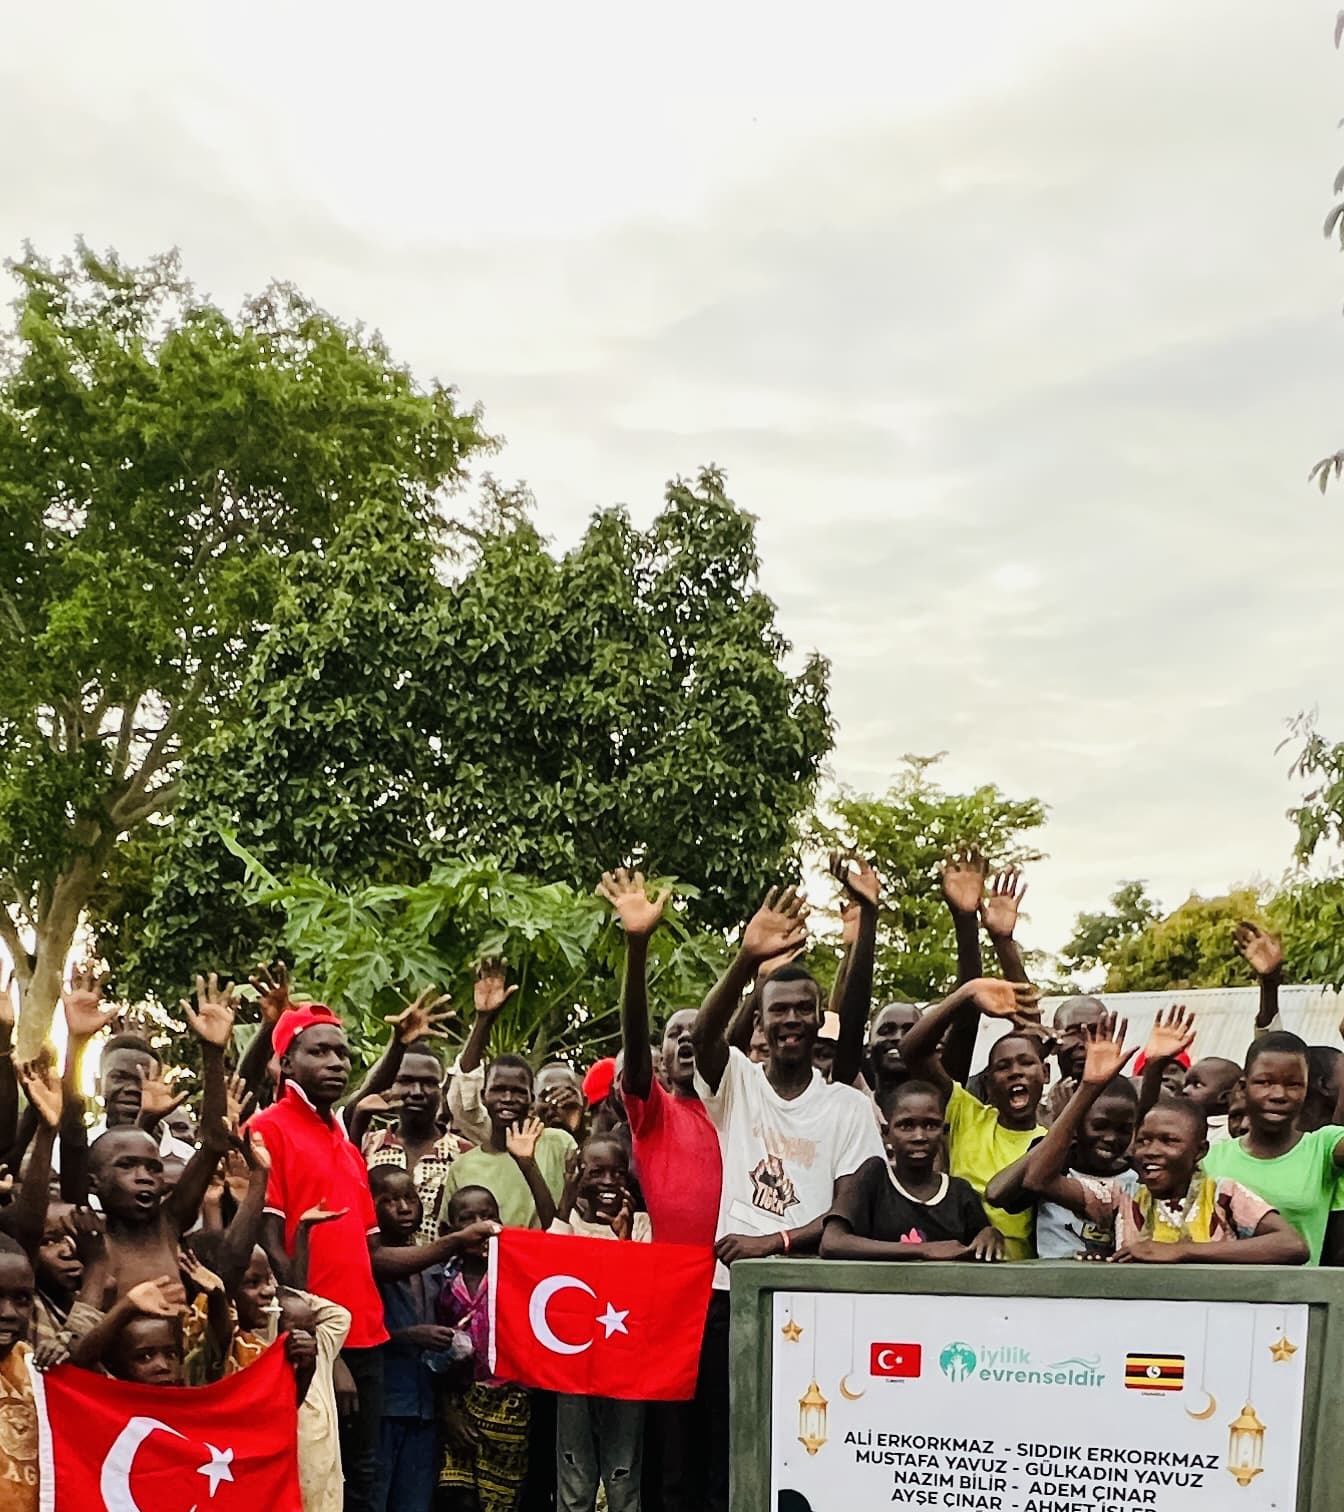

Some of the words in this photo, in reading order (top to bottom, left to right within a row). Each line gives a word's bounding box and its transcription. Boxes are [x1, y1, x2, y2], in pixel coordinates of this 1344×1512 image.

[980, 1344, 1031, 1367] iyilik
[979, 1367, 1106, 1387] evrenseldir
[844, 1428, 873, 1446] ALİ
[877, 1433, 995, 1454] ERKORKMAZ
[1016, 1442, 1082, 1461] SIDDIK
[1087, 1447, 1220, 1470] ERKORKMAZ
[855, 1450, 940, 1469] MUSTAFA
[945, 1456, 1007, 1474] YAVUZ
[1025, 1459, 1129, 1483] GÜLKADIN
[1134, 1469, 1204, 1488] YAVUZ
[891, 1488, 938, 1506] AYŞE
[943, 1492, 1002, 1511] ÇINAR
[894, 1470, 954, 1488] NAZIM
[959, 1473, 1007, 1492] BİLİR
[1028, 1481, 1086, 1499] ADEM
[1092, 1485, 1157, 1504] ÇINAR
